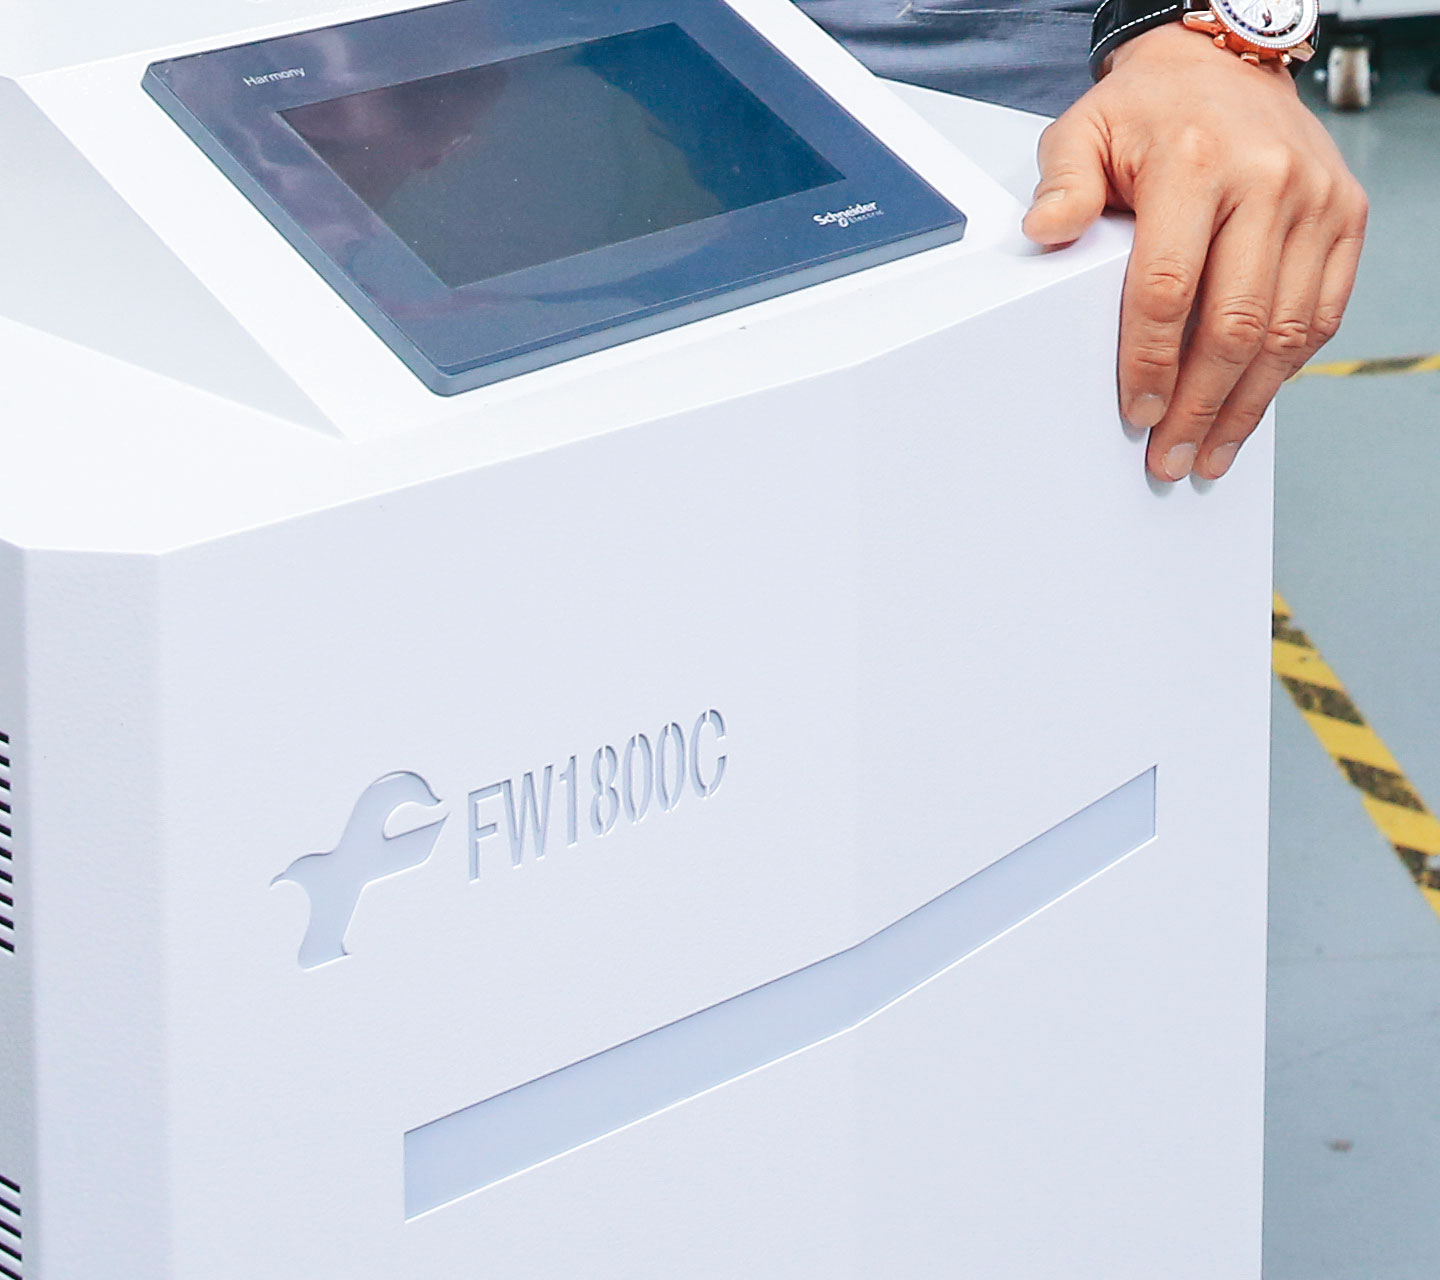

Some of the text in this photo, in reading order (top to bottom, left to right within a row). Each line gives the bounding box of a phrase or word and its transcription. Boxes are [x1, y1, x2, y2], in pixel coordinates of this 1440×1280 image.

[242, 66, 307, 88] Harmony
[812, 200, 878, 227] Schneider
[467, 708, 728, 884] FW1800C
